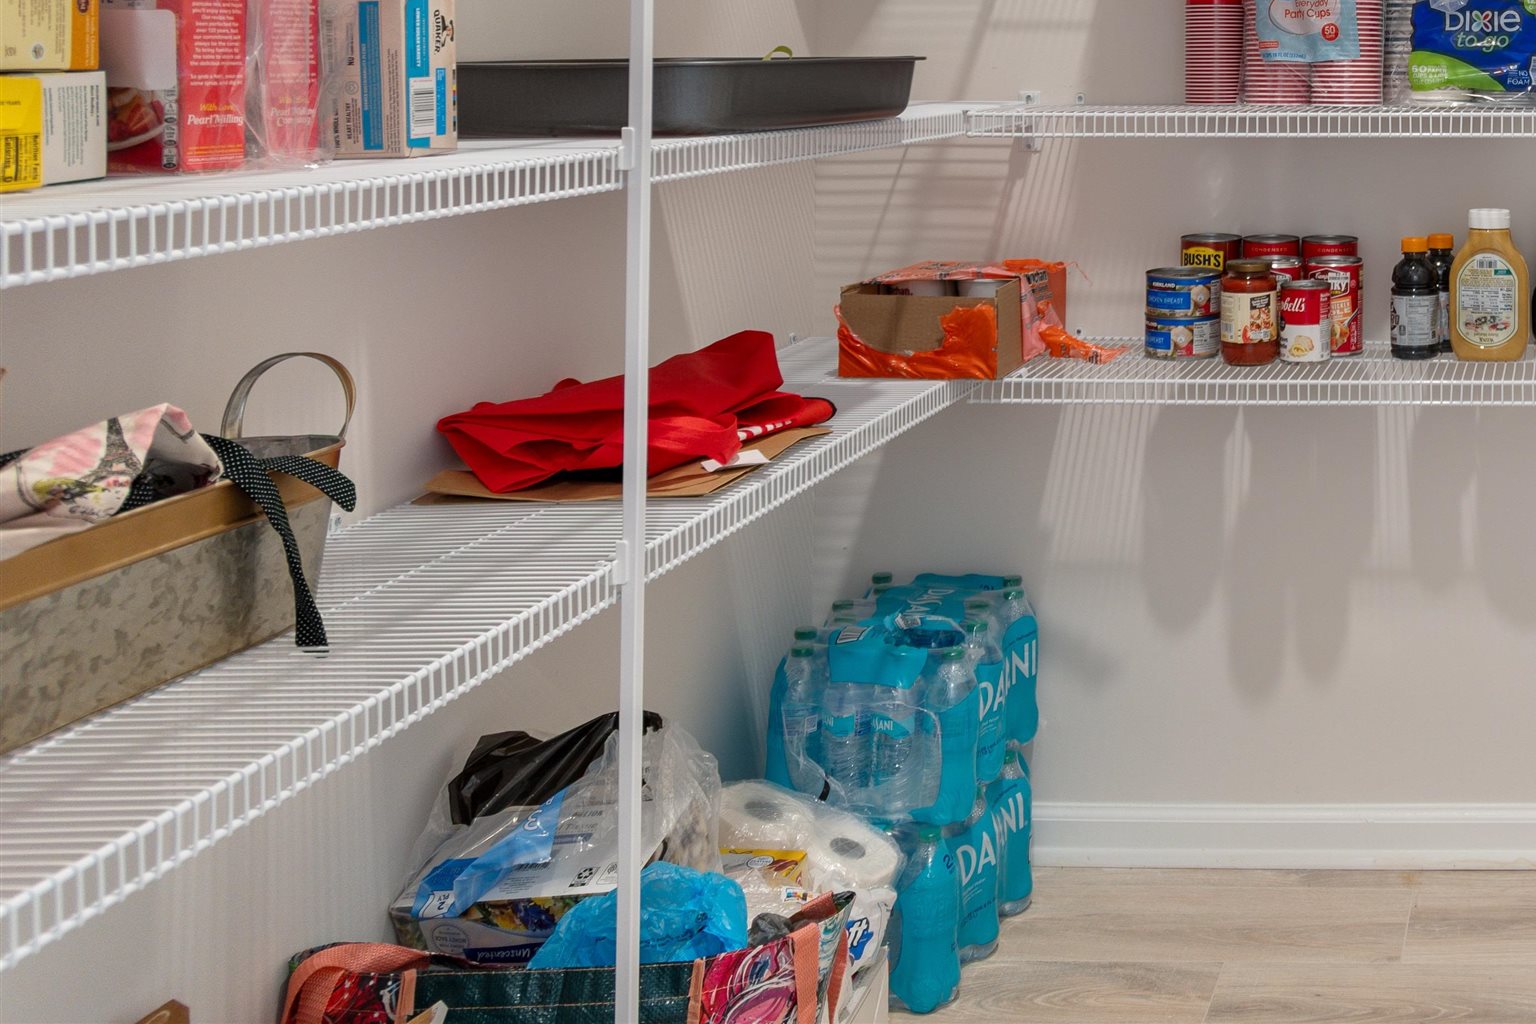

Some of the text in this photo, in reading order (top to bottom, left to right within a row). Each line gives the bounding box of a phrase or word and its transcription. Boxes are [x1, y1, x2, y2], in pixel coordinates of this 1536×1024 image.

[1295, 0, 1328, 8] Everyday
[1306, 8, 1330, 19] Cups
[433, 9, 442, 53] QUAKER
[1324, 25, 1336, 34] 50
[1456, 31, 1510, 53] to go
[1507, 77, 1530, 86] FOAM
[187, 113, 244, 126] Pearl Milling
[32, 134, 40, 180] Nutrition Facts
[1183, 253, 1222, 267] BUSH'S
[1164, 297, 1184, 305] BREAST
[1280, 297, 1306, 313] bell's
[903, 589, 955, 617] DASA
[524, 809, 542, 831] 3
[437, 893, 450, 902] PLY
[437, 901, 446, 911] 2
[476, 947, 531, 962] Unscented
